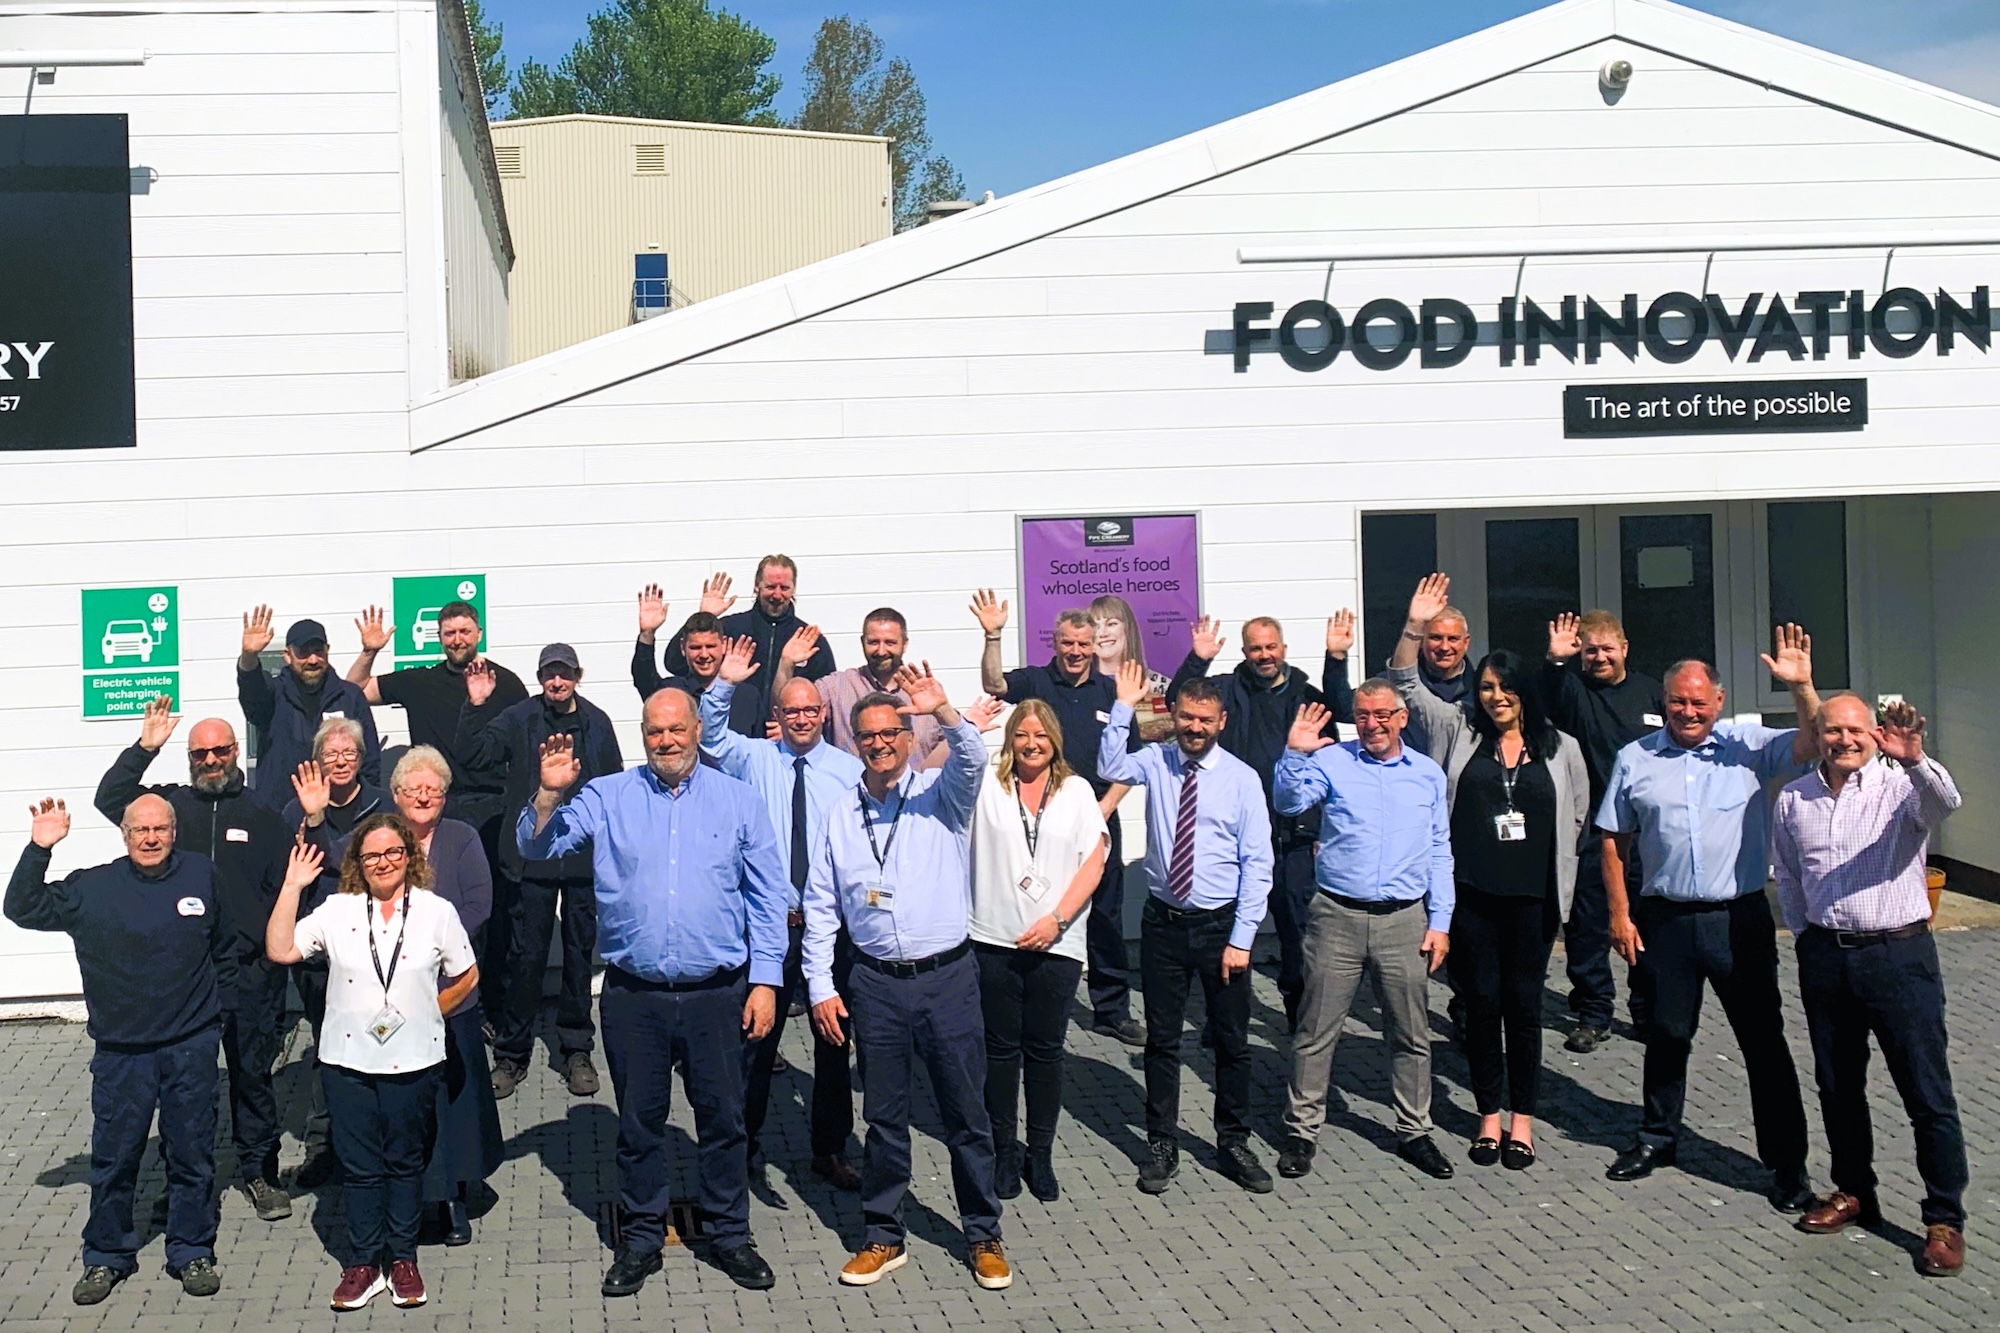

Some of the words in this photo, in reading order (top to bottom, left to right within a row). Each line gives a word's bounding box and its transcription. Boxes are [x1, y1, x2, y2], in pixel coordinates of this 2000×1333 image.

[1235, 298, 1478, 371] FOOD
[1500, 286, 1992, 368] INNOVATION
[1586, 396, 1631, 418] The
[1638, 398, 1671, 418] art
[1677, 395, 1701, 417] of
[1707, 394, 1746, 416] the
[1754, 391, 1851, 420] possible
[1133, 556, 1170, 572] food
[1042, 578, 1123, 595] wholesale
[1127, 578, 1180, 592] heroes
[93, 678, 132, 688] Electric
[135, 676, 172, 686] vehicle
[104, 689, 161, 700] recharging
[106, 701, 134, 713] point
